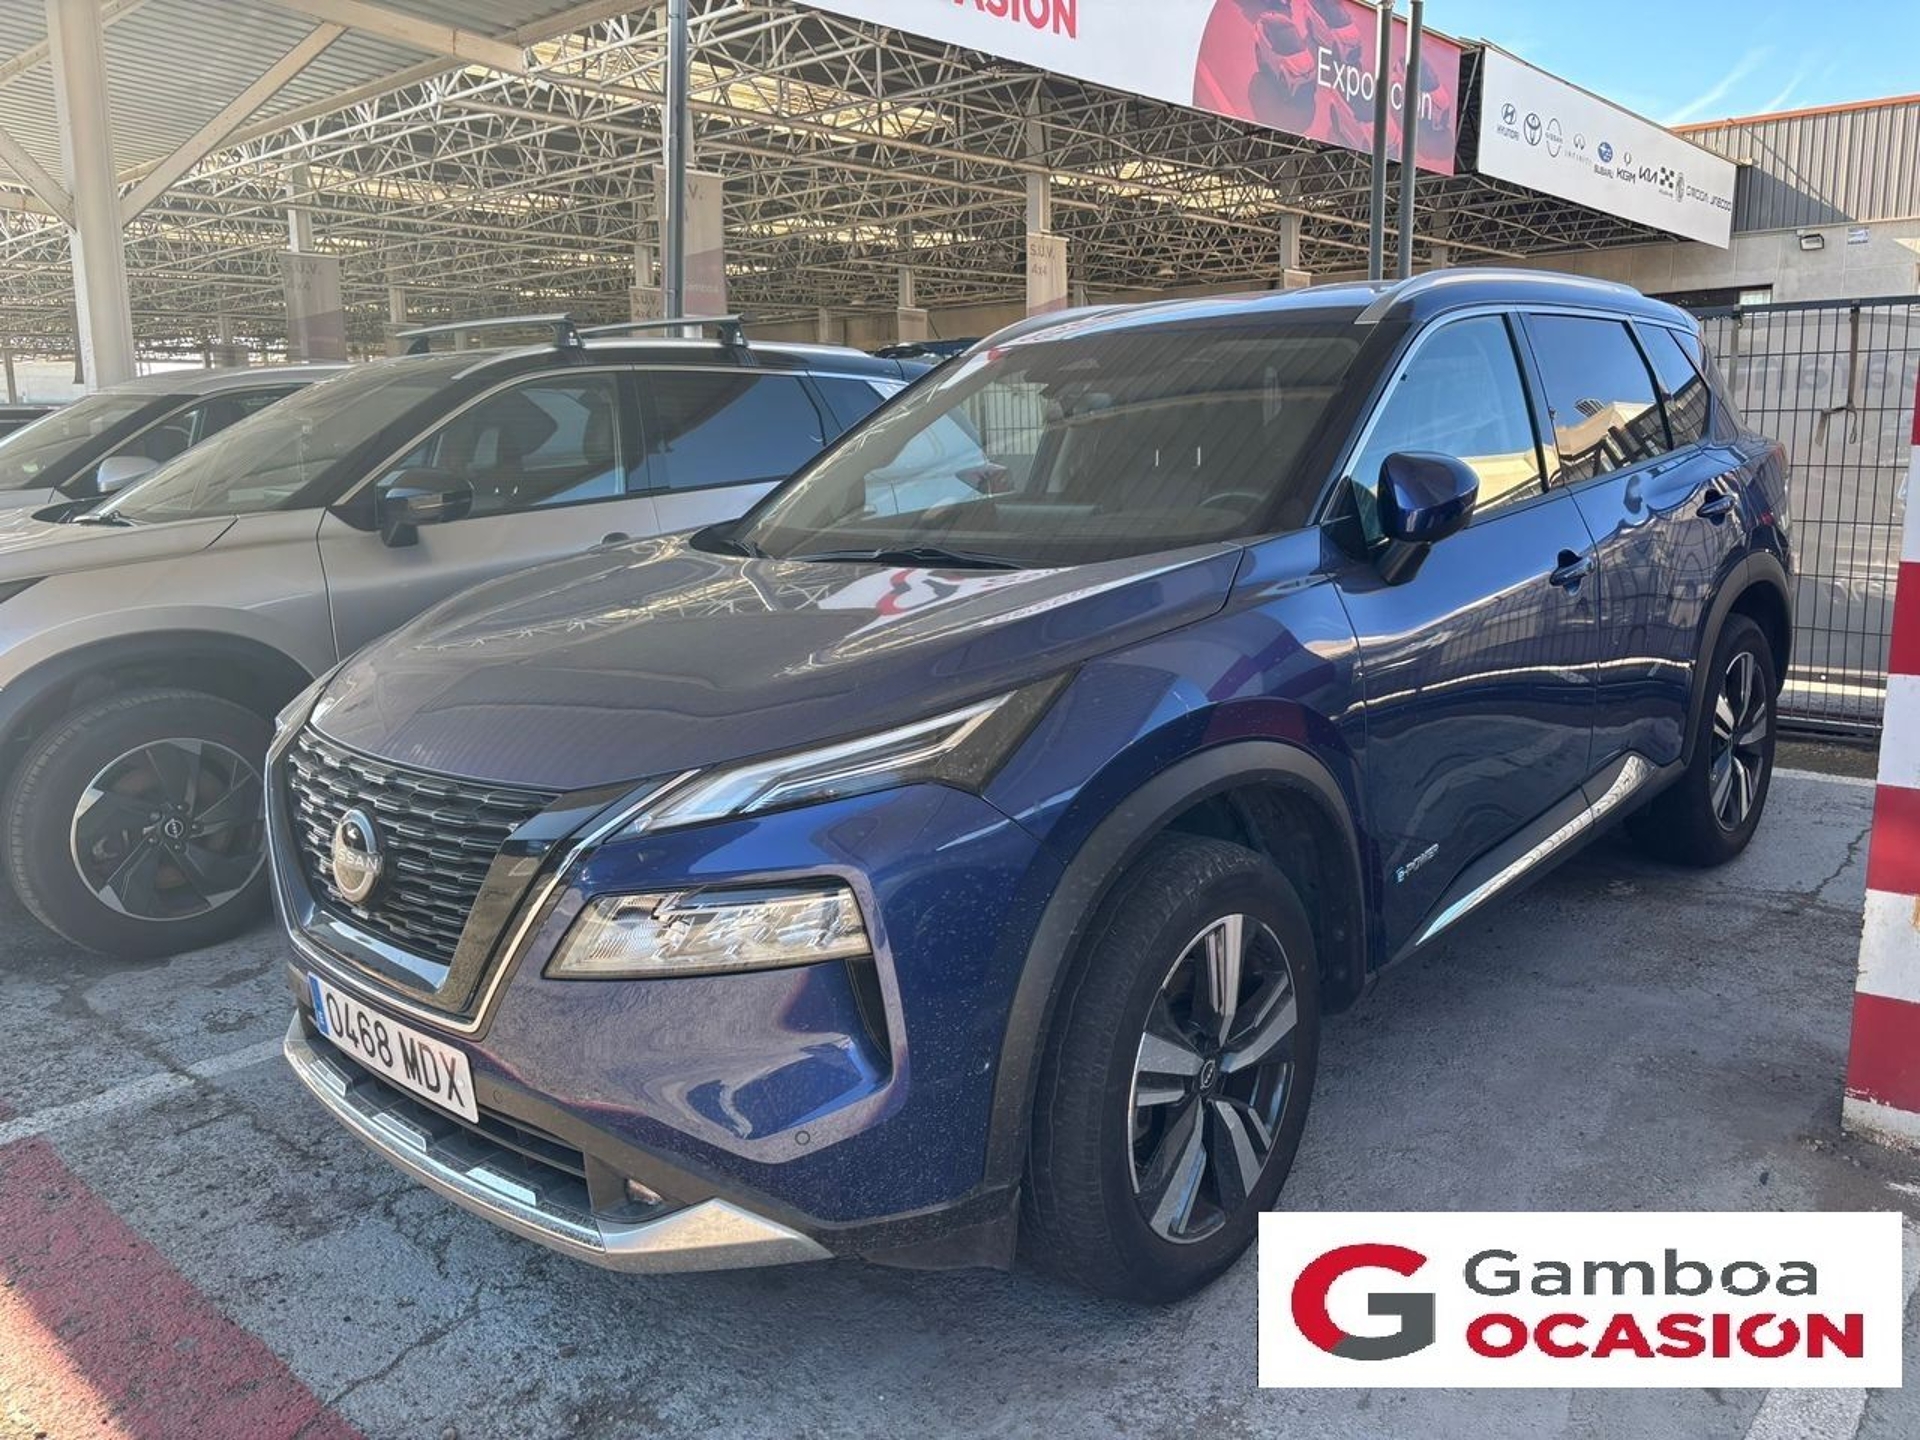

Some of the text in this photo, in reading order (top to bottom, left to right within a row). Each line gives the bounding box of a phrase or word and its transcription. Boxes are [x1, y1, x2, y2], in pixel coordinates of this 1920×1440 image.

[1317, 46, 1432, 121] Expocn
[1616, 167, 1636, 184] KGM
[326, 992, 466, 1108] 0468 MDX
